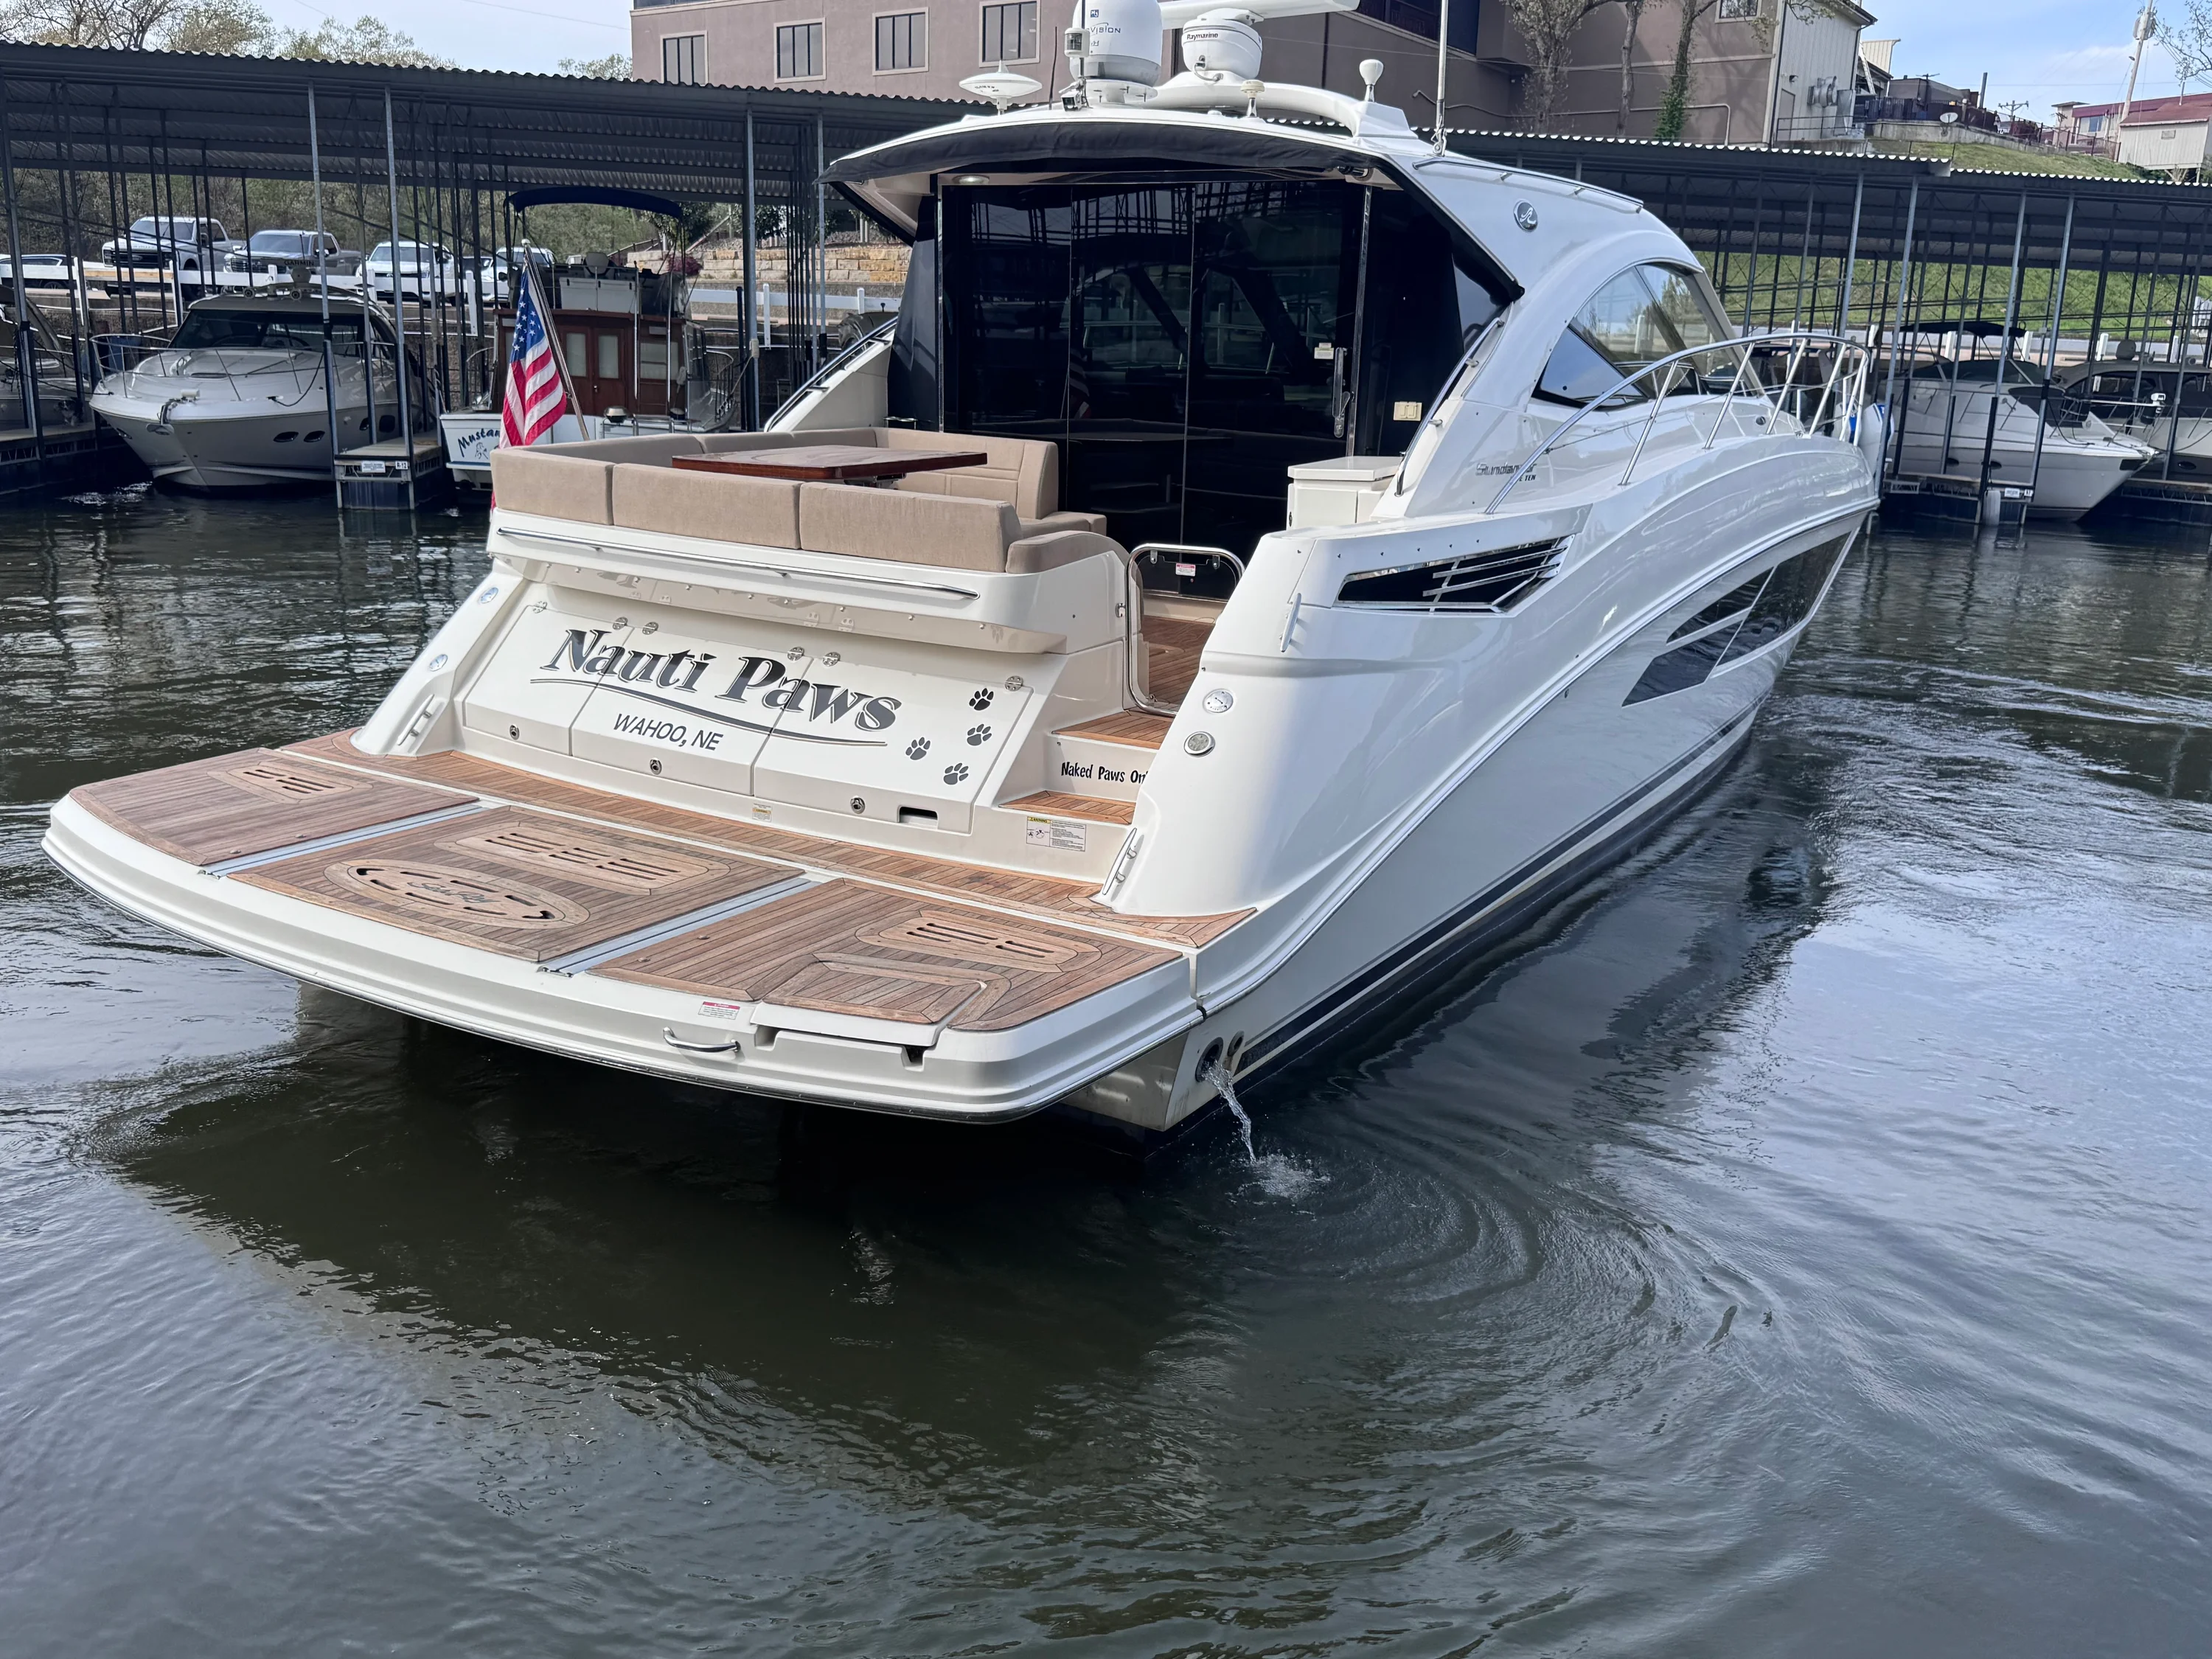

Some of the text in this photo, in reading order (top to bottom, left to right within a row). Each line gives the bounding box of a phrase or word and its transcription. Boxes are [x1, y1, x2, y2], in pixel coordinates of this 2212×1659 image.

[1087, 26, 1121, 35] VISION
[1186, 32, 1219, 41] Raymarine
[458, 428, 501, 458] Mustan
[540, 630, 902, 731] Nauti Paws
[613, 713, 724, 751] WAHOO, NE
[1061, 762, 1148, 784] Naked Paws On
